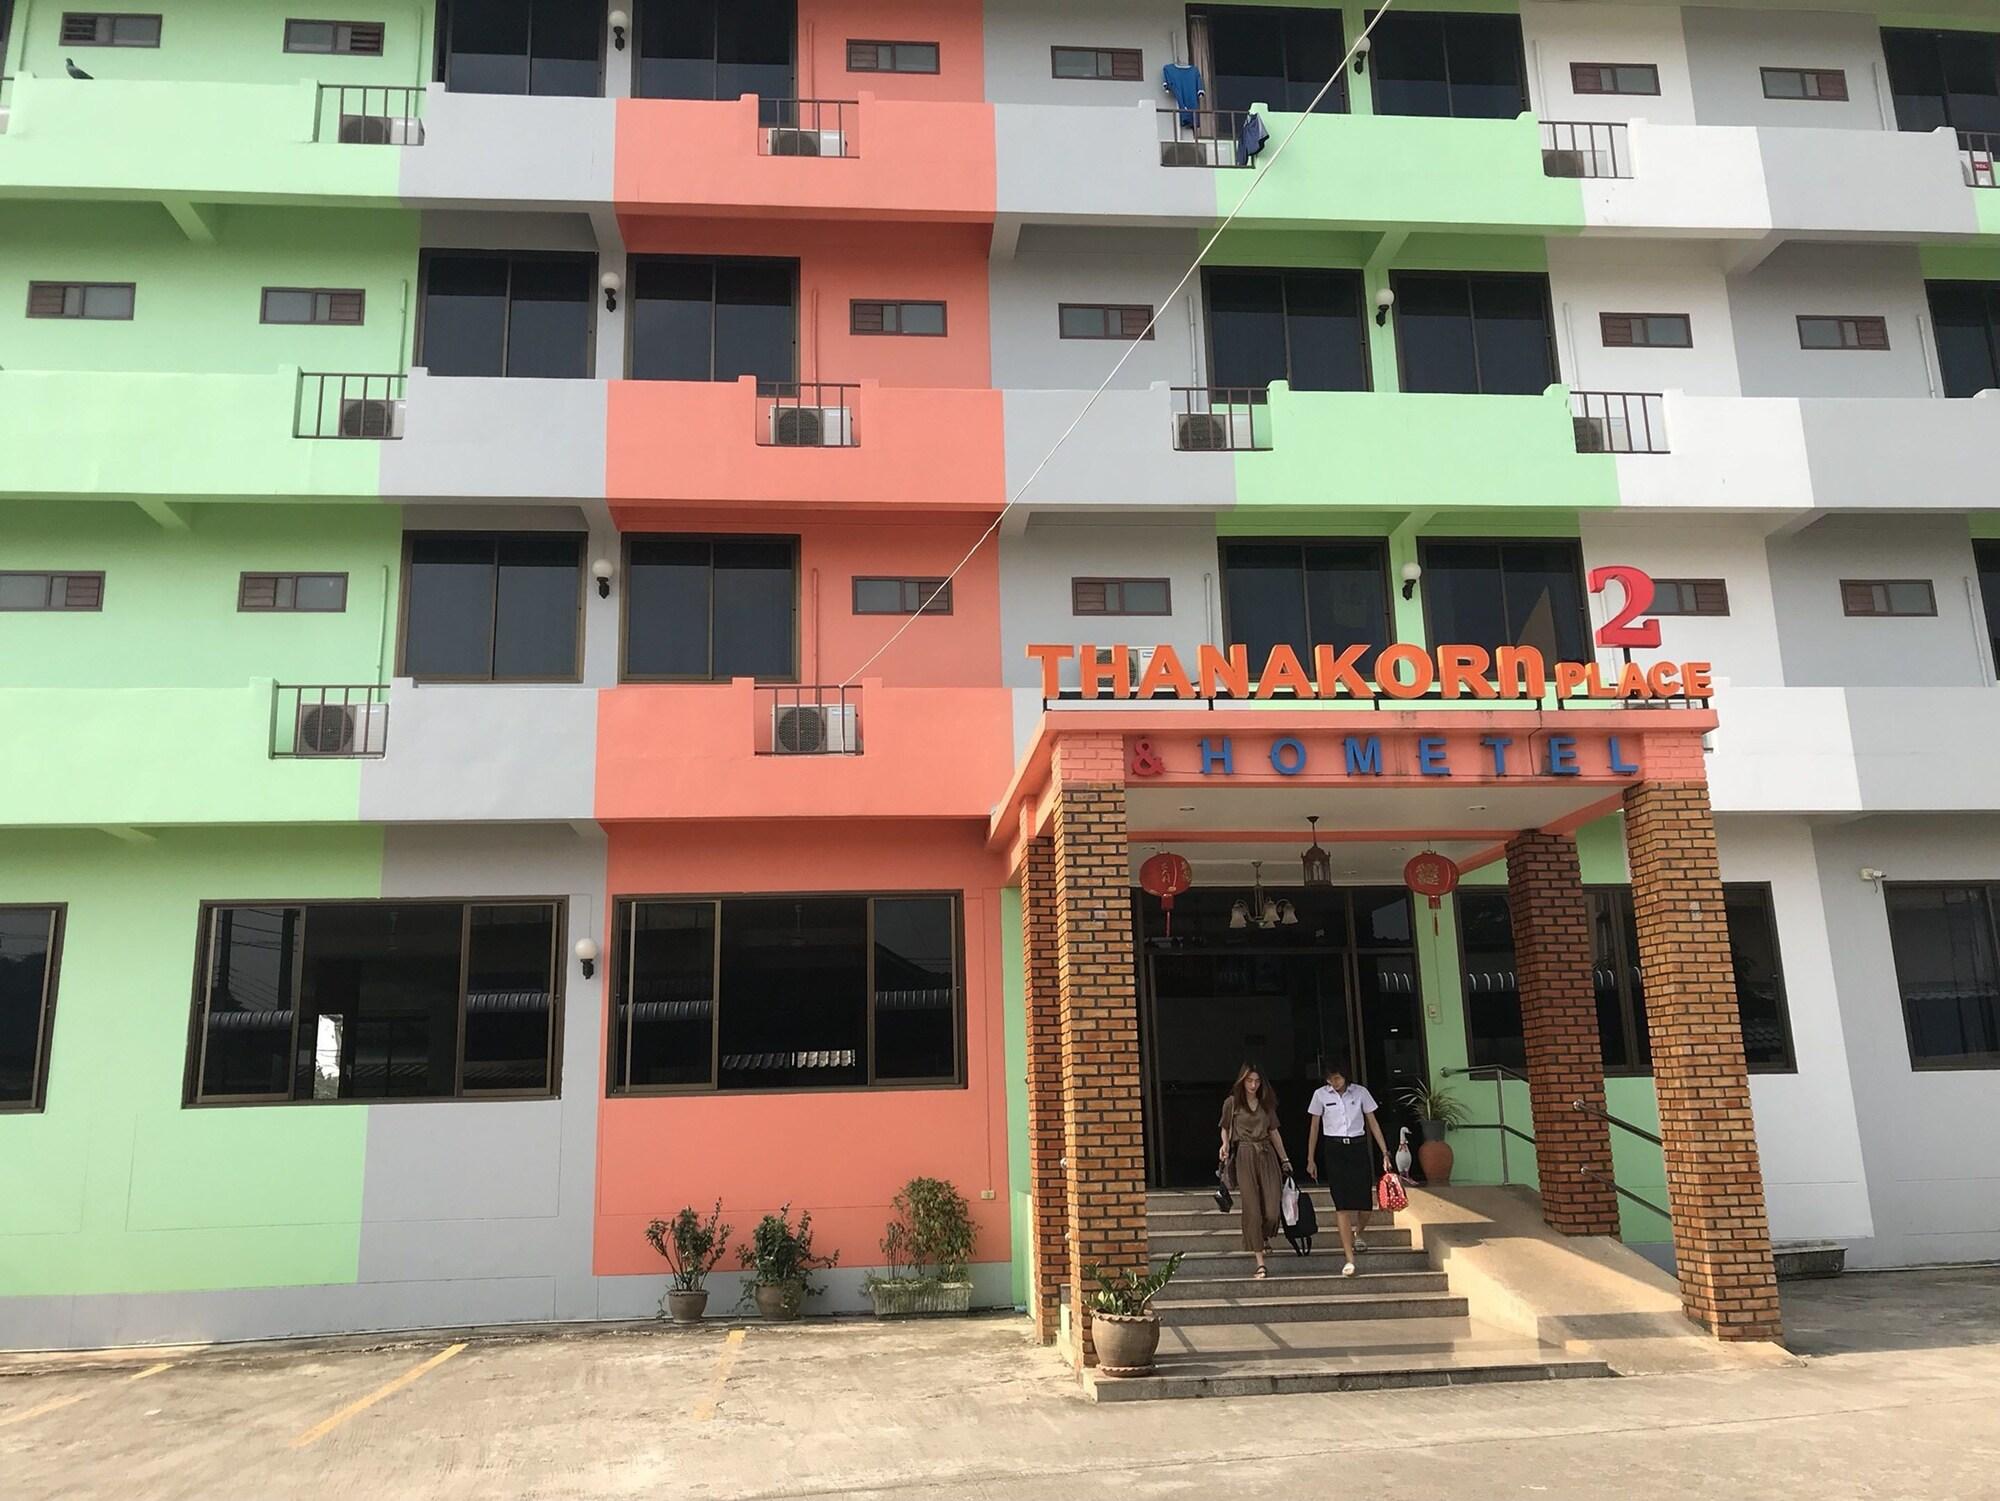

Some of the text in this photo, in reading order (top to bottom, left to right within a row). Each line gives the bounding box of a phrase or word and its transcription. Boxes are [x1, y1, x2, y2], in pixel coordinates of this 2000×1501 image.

[1588, 565, 1662, 648] 2
[1555, 661, 1714, 699] PLACE
[1131, 735, 1640, 777] & HOMETEL
